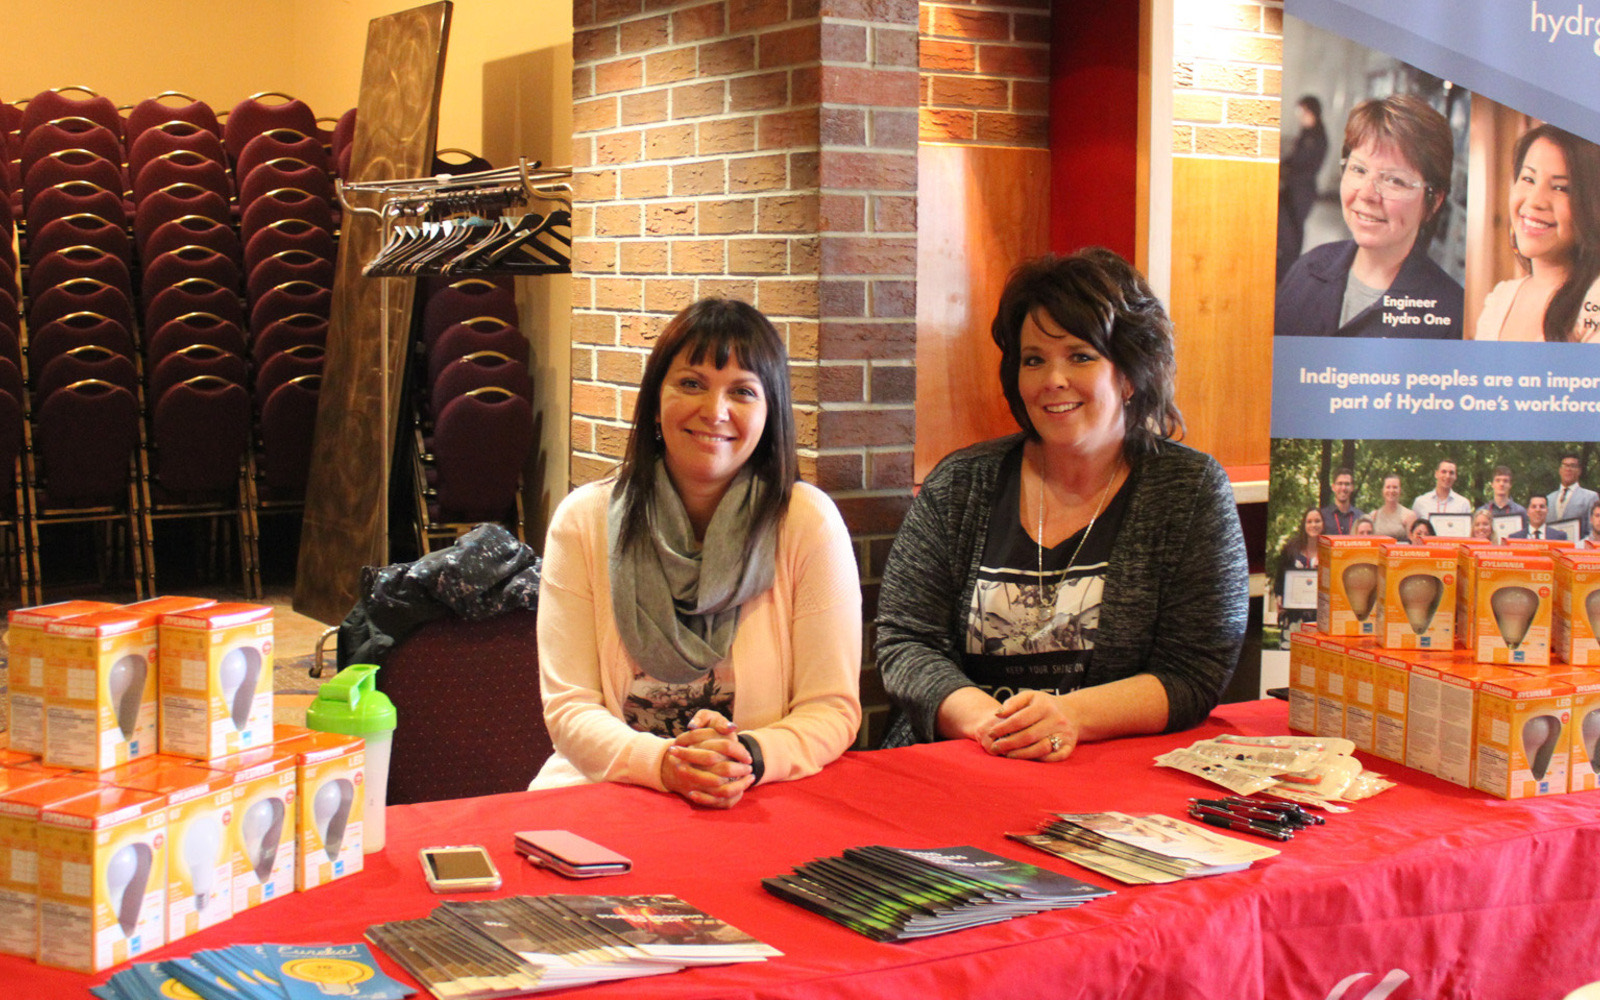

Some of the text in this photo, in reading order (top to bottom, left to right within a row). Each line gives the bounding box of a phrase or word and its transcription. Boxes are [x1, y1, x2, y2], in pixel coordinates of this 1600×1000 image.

[1383, 295, 1437, 310] Engineer
[1382, 312, 1451, 327] Hydro One
[1300, 367, 1400, 389] Indigenous
[1406, 369, 1478, 390] peoples
[1483, 375, 1513, 387] are
[1518, 376, 1541, 387] an
[1329, 395, 1369, 414] part
[1373, 392, 1392, 409] of
[1397, 393, 1455, 414] Hydro
[1481, 560, 1525, 568] SYLVANIA
[1530, 573, 1551, 581] LED
